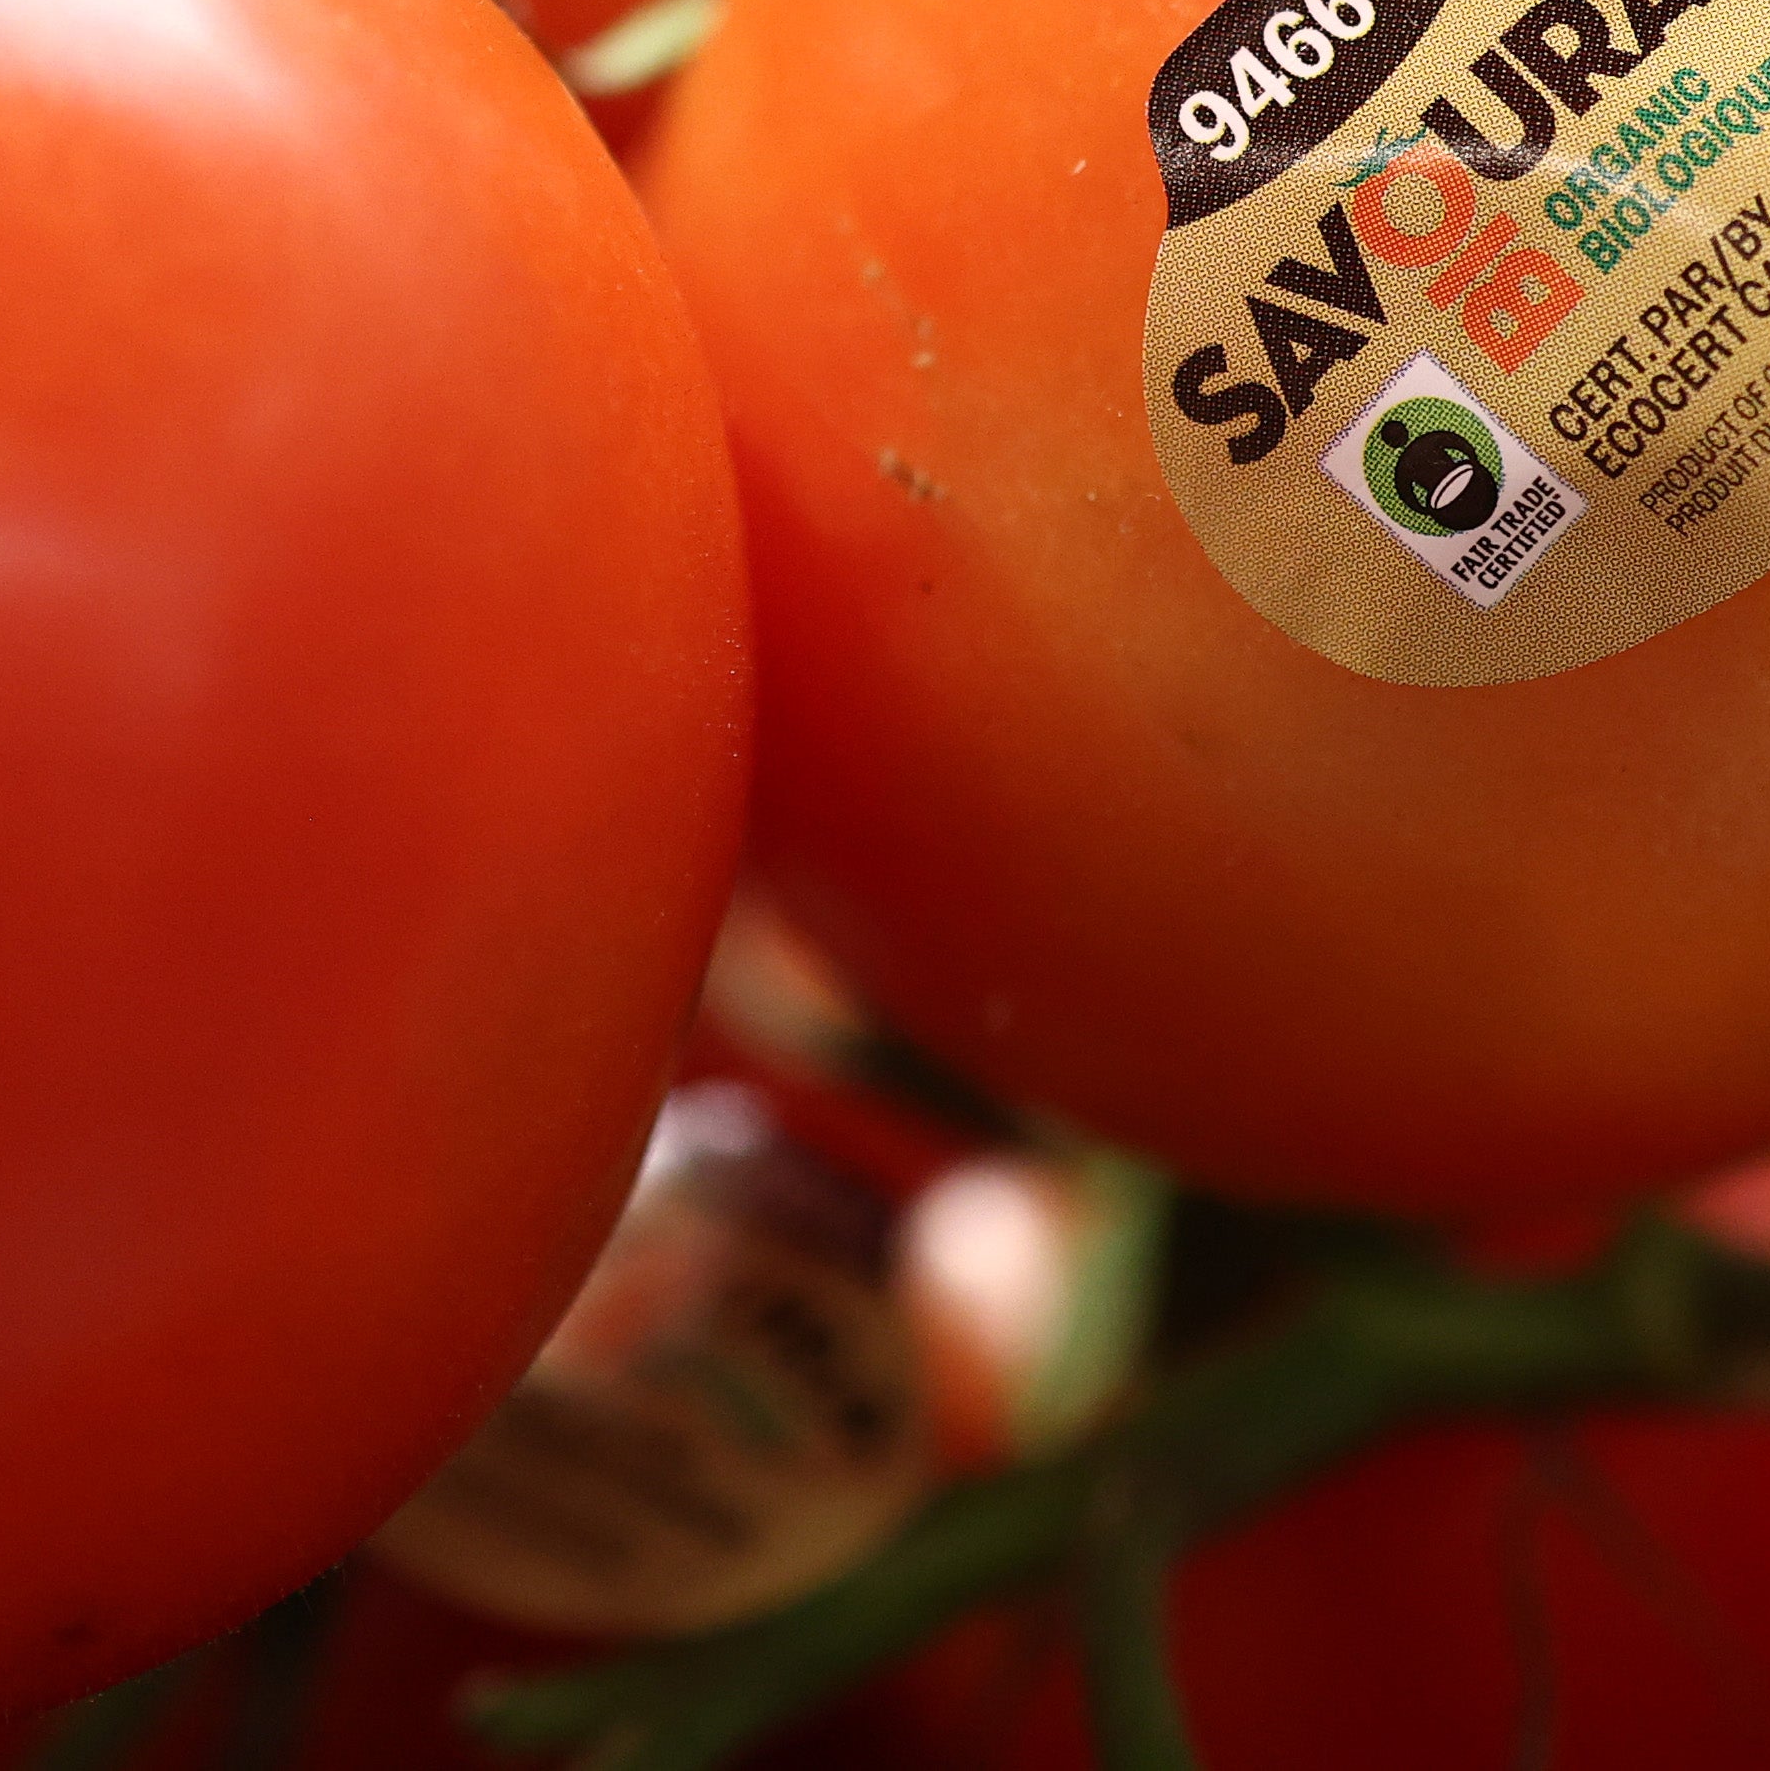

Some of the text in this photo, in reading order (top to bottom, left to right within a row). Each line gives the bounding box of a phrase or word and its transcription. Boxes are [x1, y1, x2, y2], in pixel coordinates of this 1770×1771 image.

[1544, 68, 1711, 230] ORGANIC
[1549, 335, 1659, 443] CERT.
[1583, 305, 1748, 479] ECOCERT
[1639, 410, 1743, 515] PRODUCT
[1733, 380, 1767, 421] OF
[1665, 444, 1760, 538] PRODUIT
[1450, 475, 1556, 583] FAIR TRADE
[1477, 500, 1567, 590] CERTIFIED
